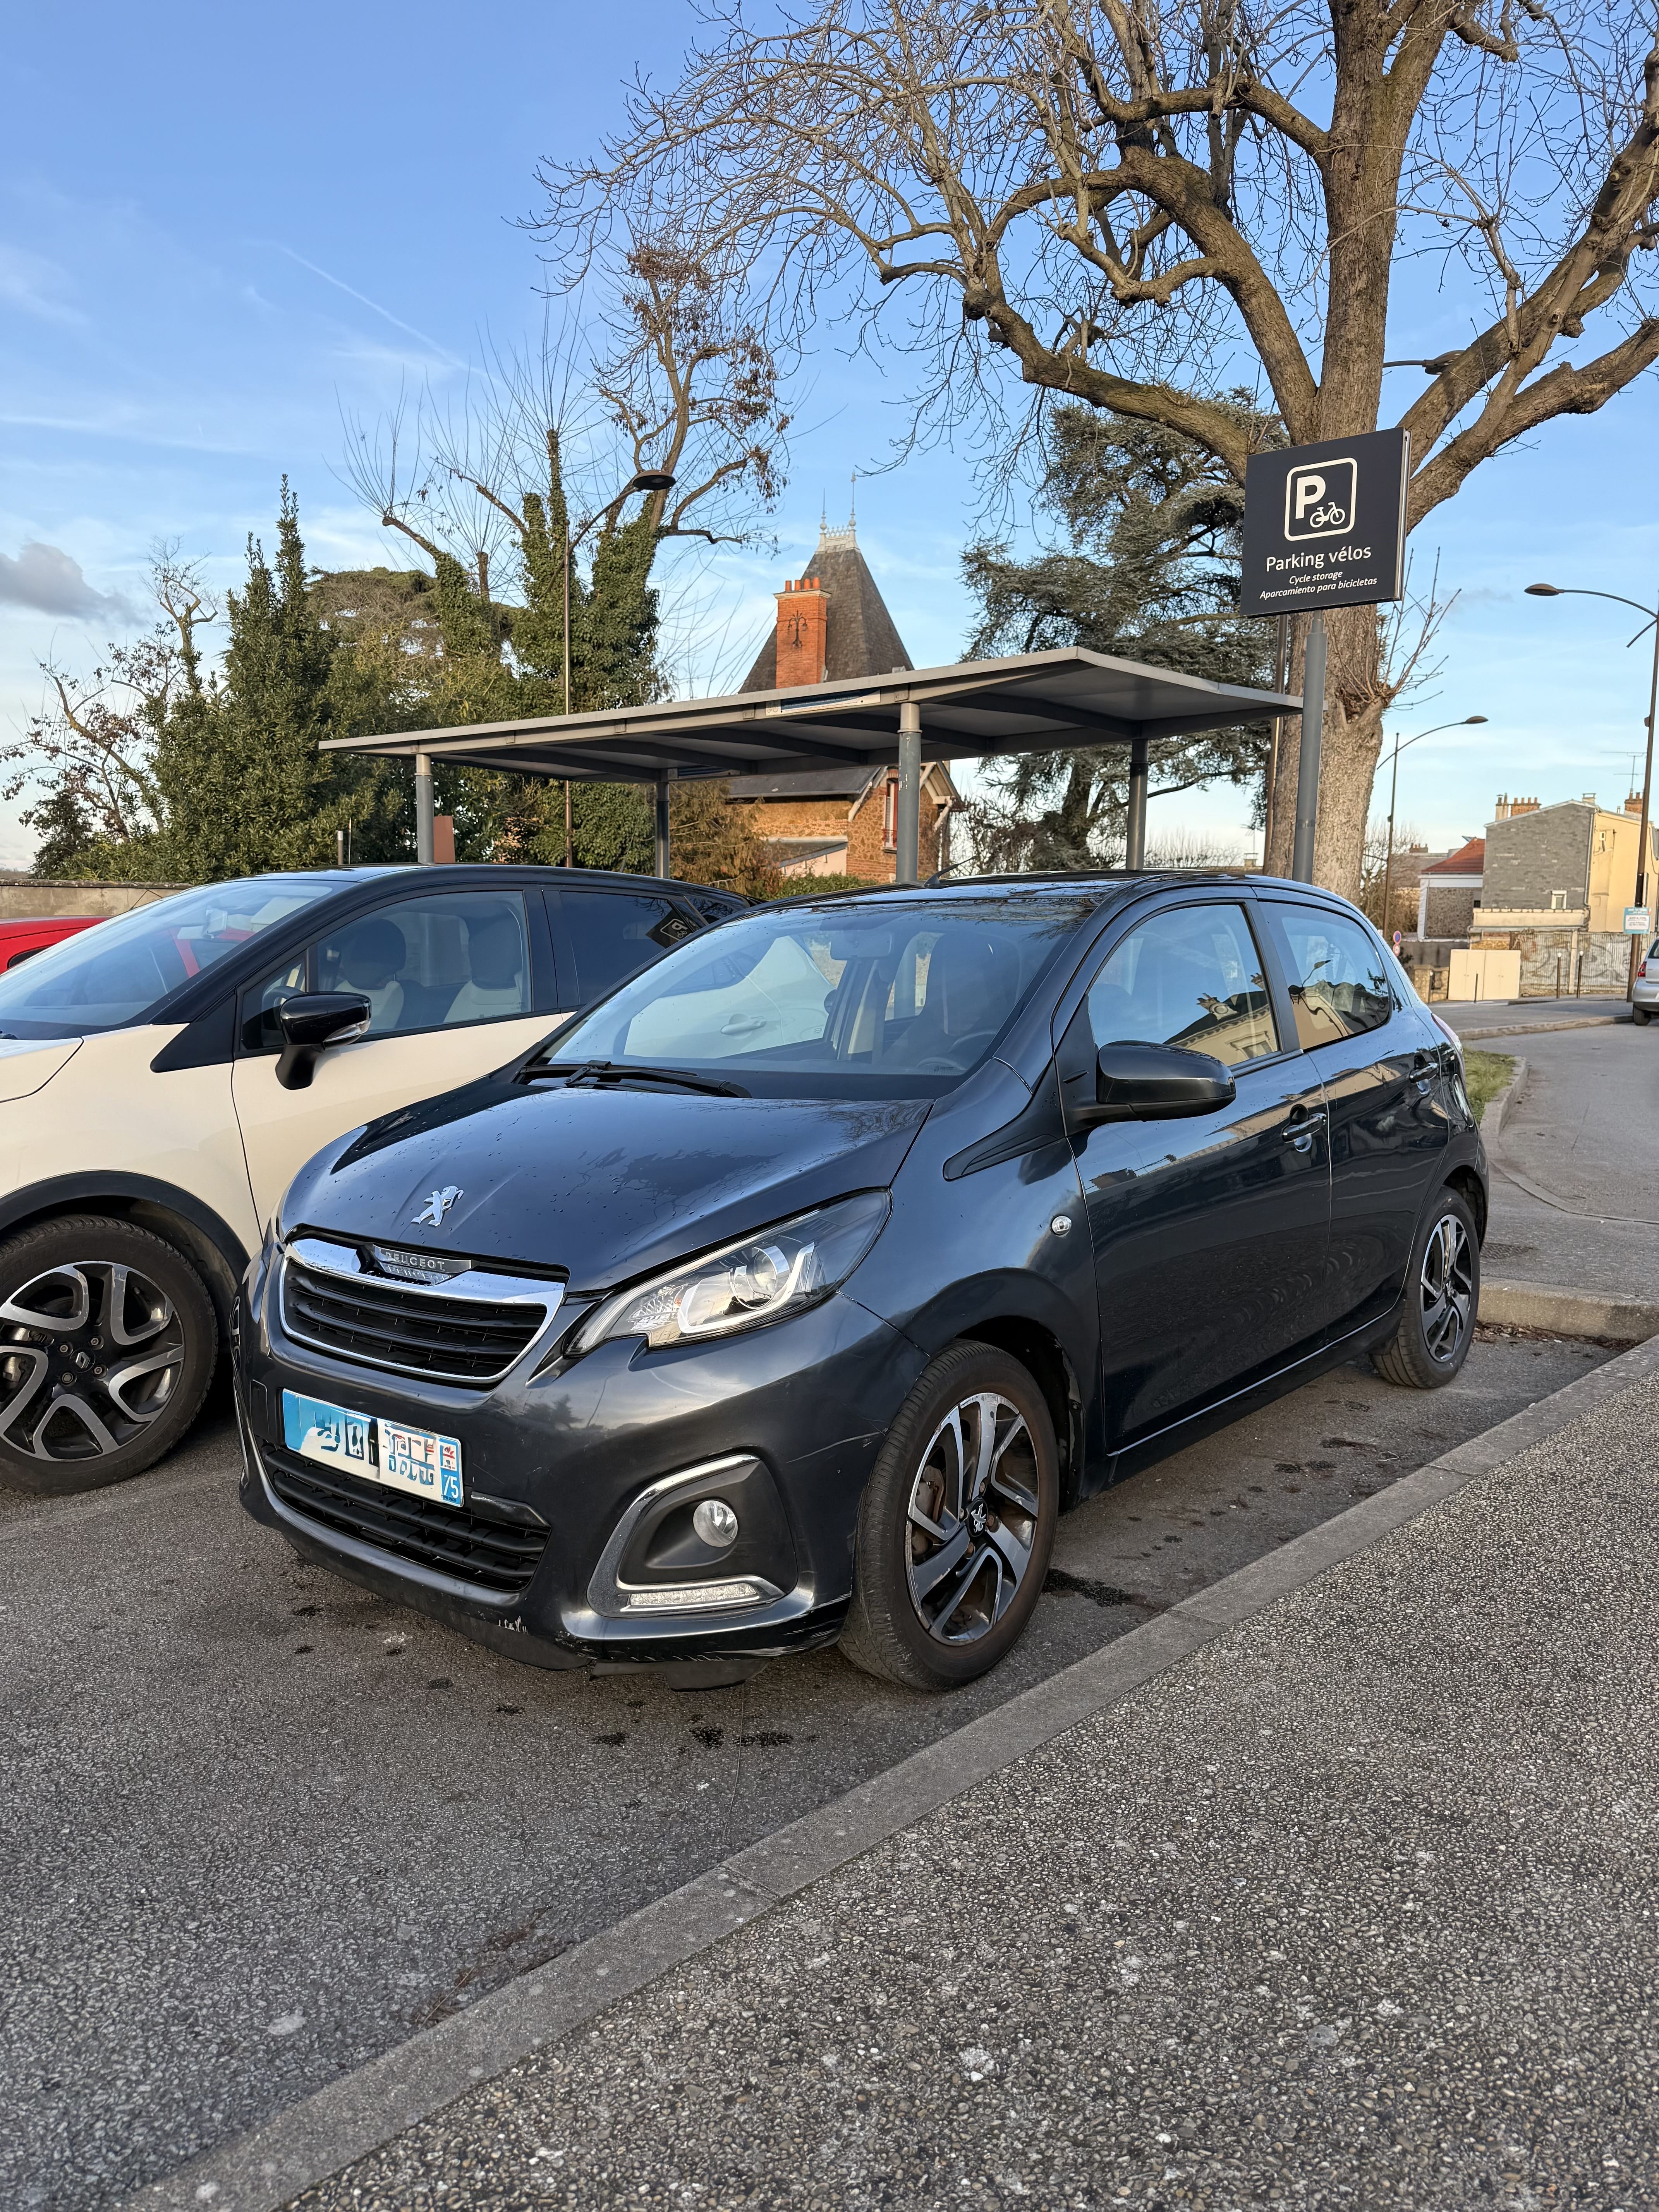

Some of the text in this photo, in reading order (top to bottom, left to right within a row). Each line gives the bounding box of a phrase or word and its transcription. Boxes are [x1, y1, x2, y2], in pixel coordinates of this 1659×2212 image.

[1295, 475, 1326, 519] P
[1266, 546, 1371, 572] Parking vélos
[1259, 577, 1378, 600] Aparcamiento para bicicletas
[1289, 571, 1343, 586] Cycle storage
[385, 1251, 445, 1270] PEUGEOT
[443, 1474, 459, 1499] 75
